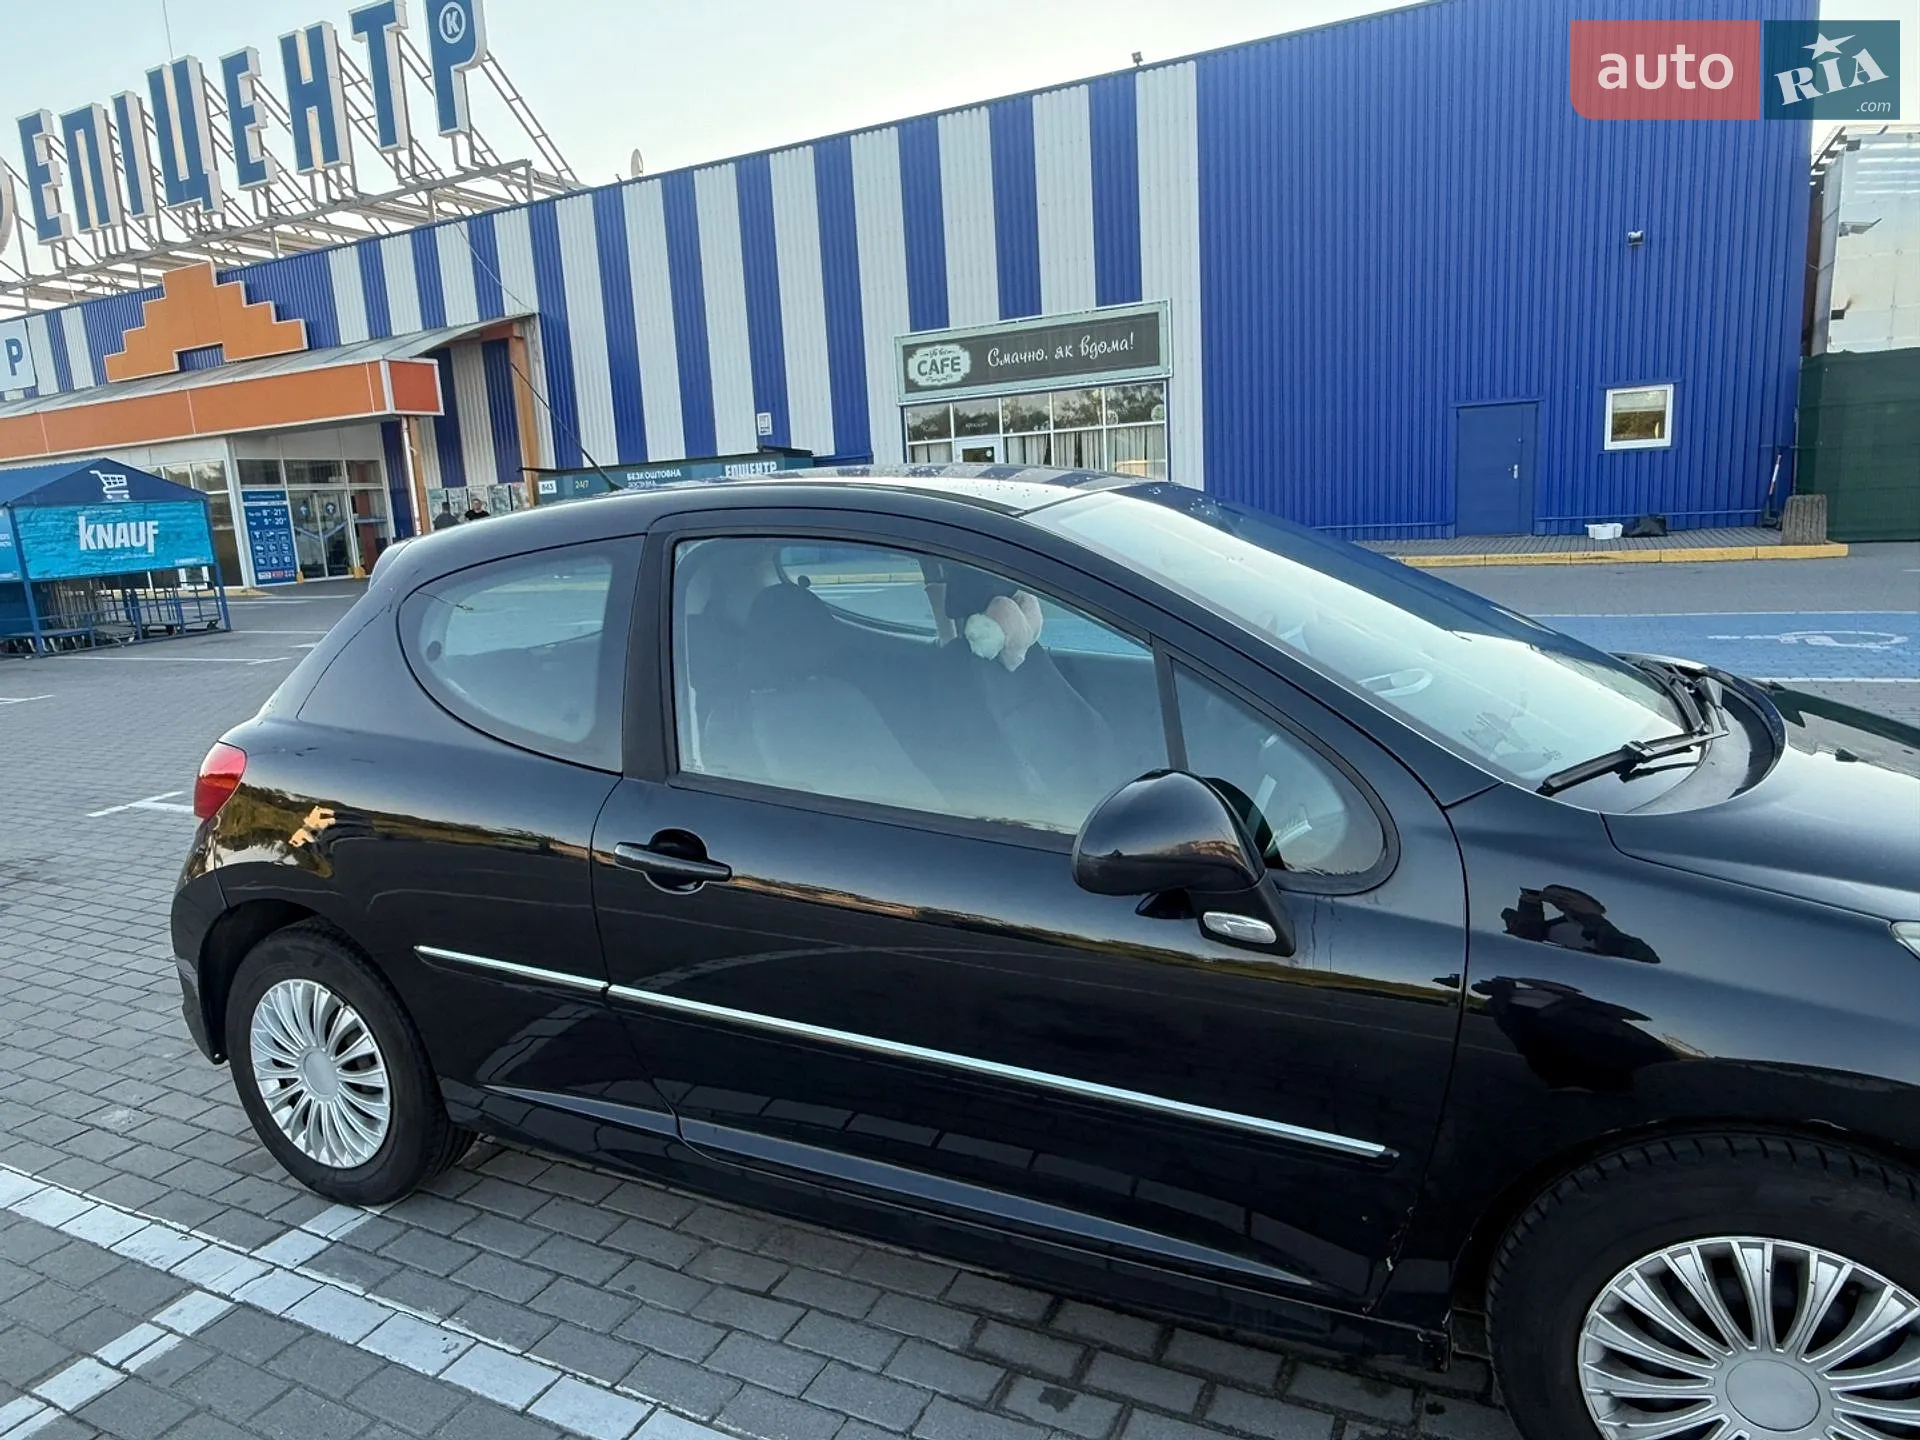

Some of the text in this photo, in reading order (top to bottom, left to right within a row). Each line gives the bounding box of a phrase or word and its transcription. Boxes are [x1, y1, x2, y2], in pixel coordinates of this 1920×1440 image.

[15, 0, 487, 247] ЕПІЦЕНТР
[1054, 344, 1074, 360] як
[1080, 331, 1134, 360] вдома!
[917, 356, 961, 376] CAFE
[78, 515, 158, 553] KNAUF
